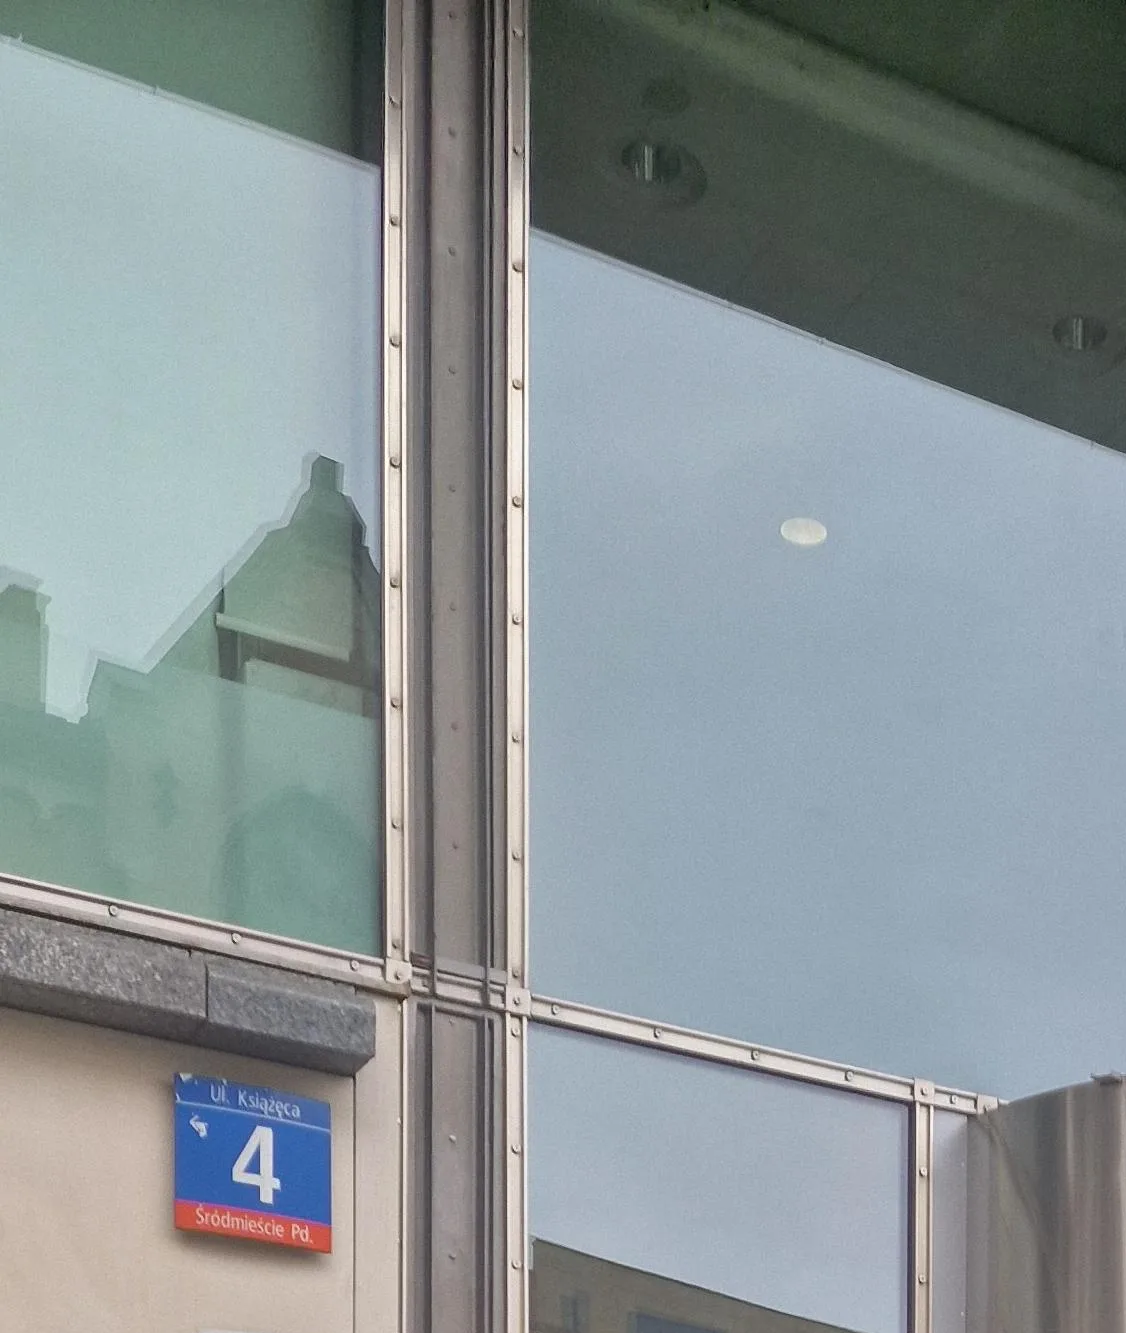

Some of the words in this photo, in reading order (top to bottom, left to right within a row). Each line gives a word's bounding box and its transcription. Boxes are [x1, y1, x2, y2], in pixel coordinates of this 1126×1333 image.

[238, 1088, 301, 1119] Książęca
[232, 1125, 281, 1204] 4
[196, 1205, 285, 1237] Śródmieście
[291, 1224, 313, 1244] Pd.
